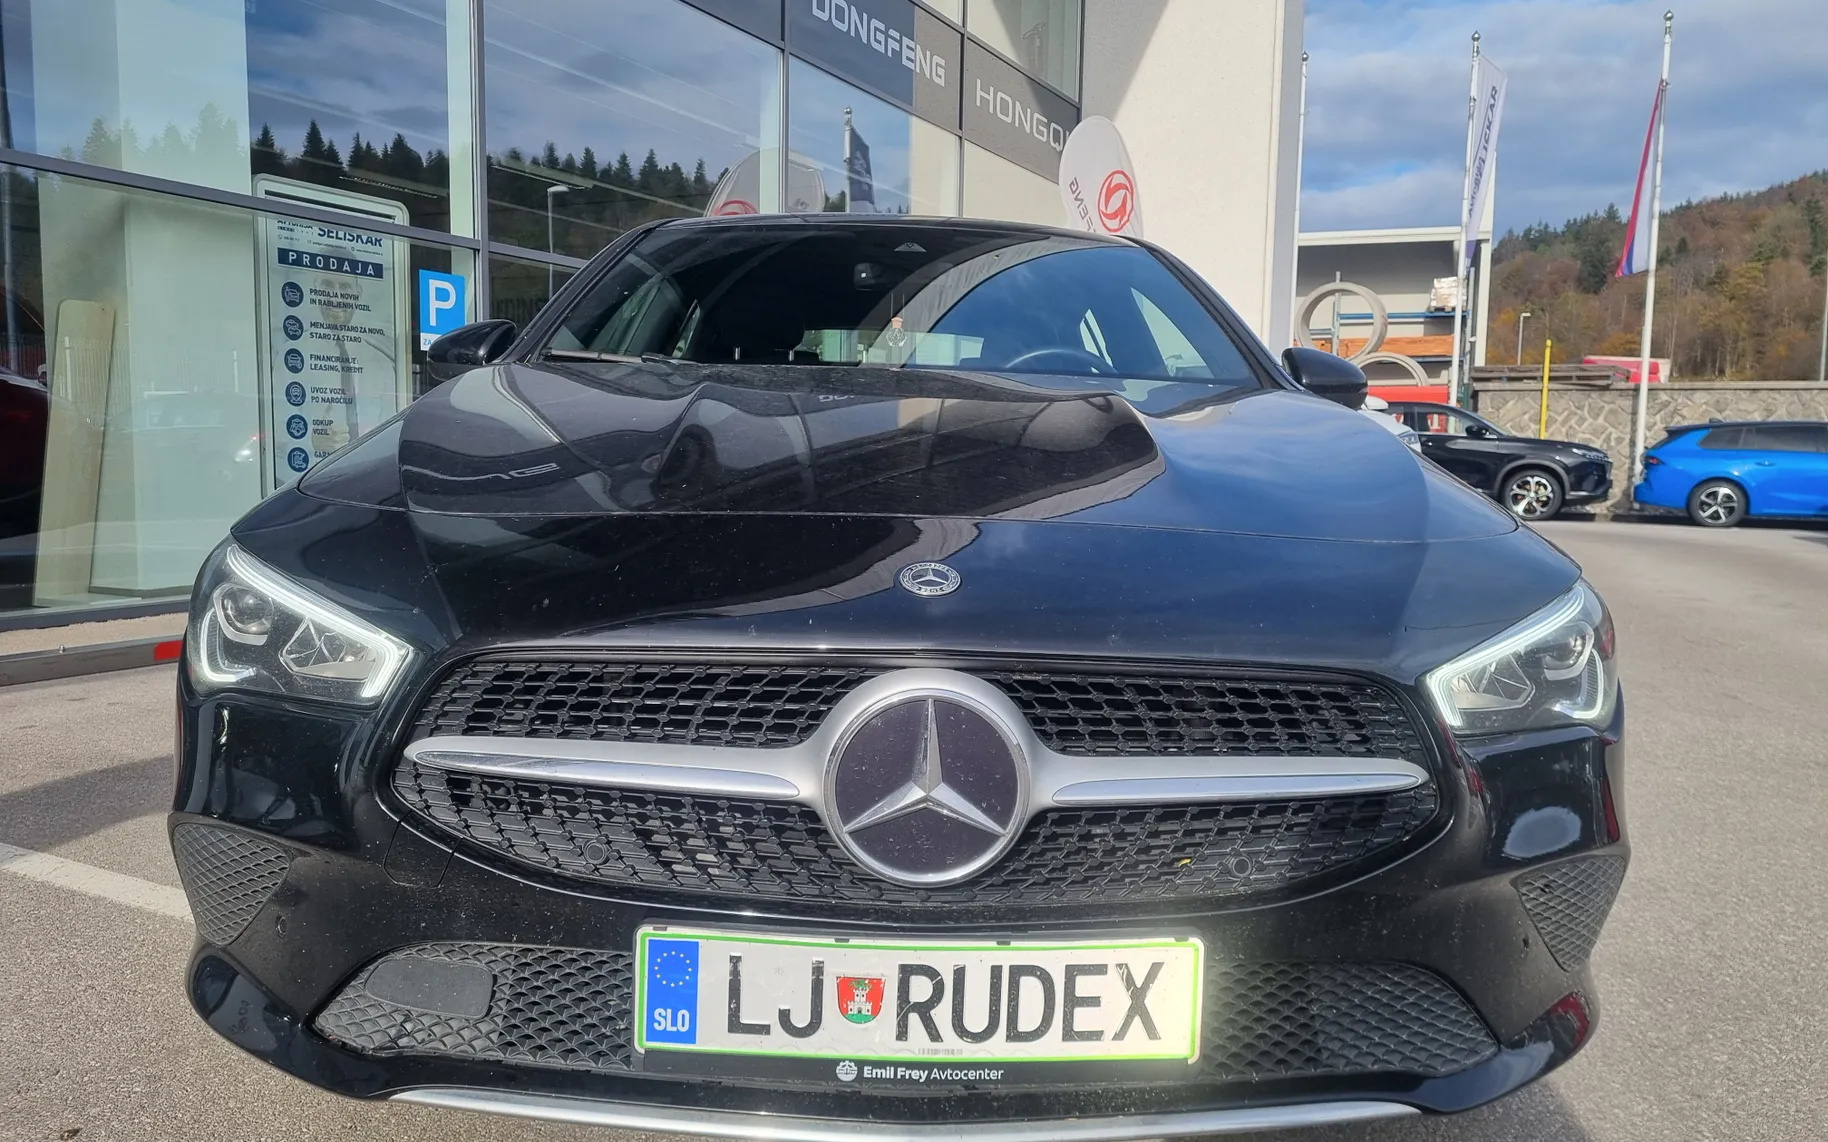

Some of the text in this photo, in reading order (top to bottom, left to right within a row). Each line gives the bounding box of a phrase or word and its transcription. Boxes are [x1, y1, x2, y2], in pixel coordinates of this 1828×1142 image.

[812, 0, 946, 87] DONGFENG
[289, 251, 375, 276] PRODAJA
[309, 288, 359, 301] PRODAJA NOVIH
[318, 299, 353, 310] RABLJENIH
[354, 303, 372, 312] VOZIL
[428, 278, 456, 327] P
[310, 322, 385, 336] MENJAVA STARO ZA NOVO,
[310, 332, 362, 343] STARO ZA STARO
[310, 363, 364, 374] LEASING, KREDIT
[310, 386, 328, 394] UVOZ
[321, 396, 353, 404] NAROČILU
[313, 428, 330, 436] VOZIL
[727, 954, 1165, 1042] LJ RUDEX
[654, 1008, 690, 1032] SLO
[864, 1066, 895, 1079] Emil
[896, 1066, 928, 1082] Frey
[930, 1066, 1004, 1080] Avtocenter
